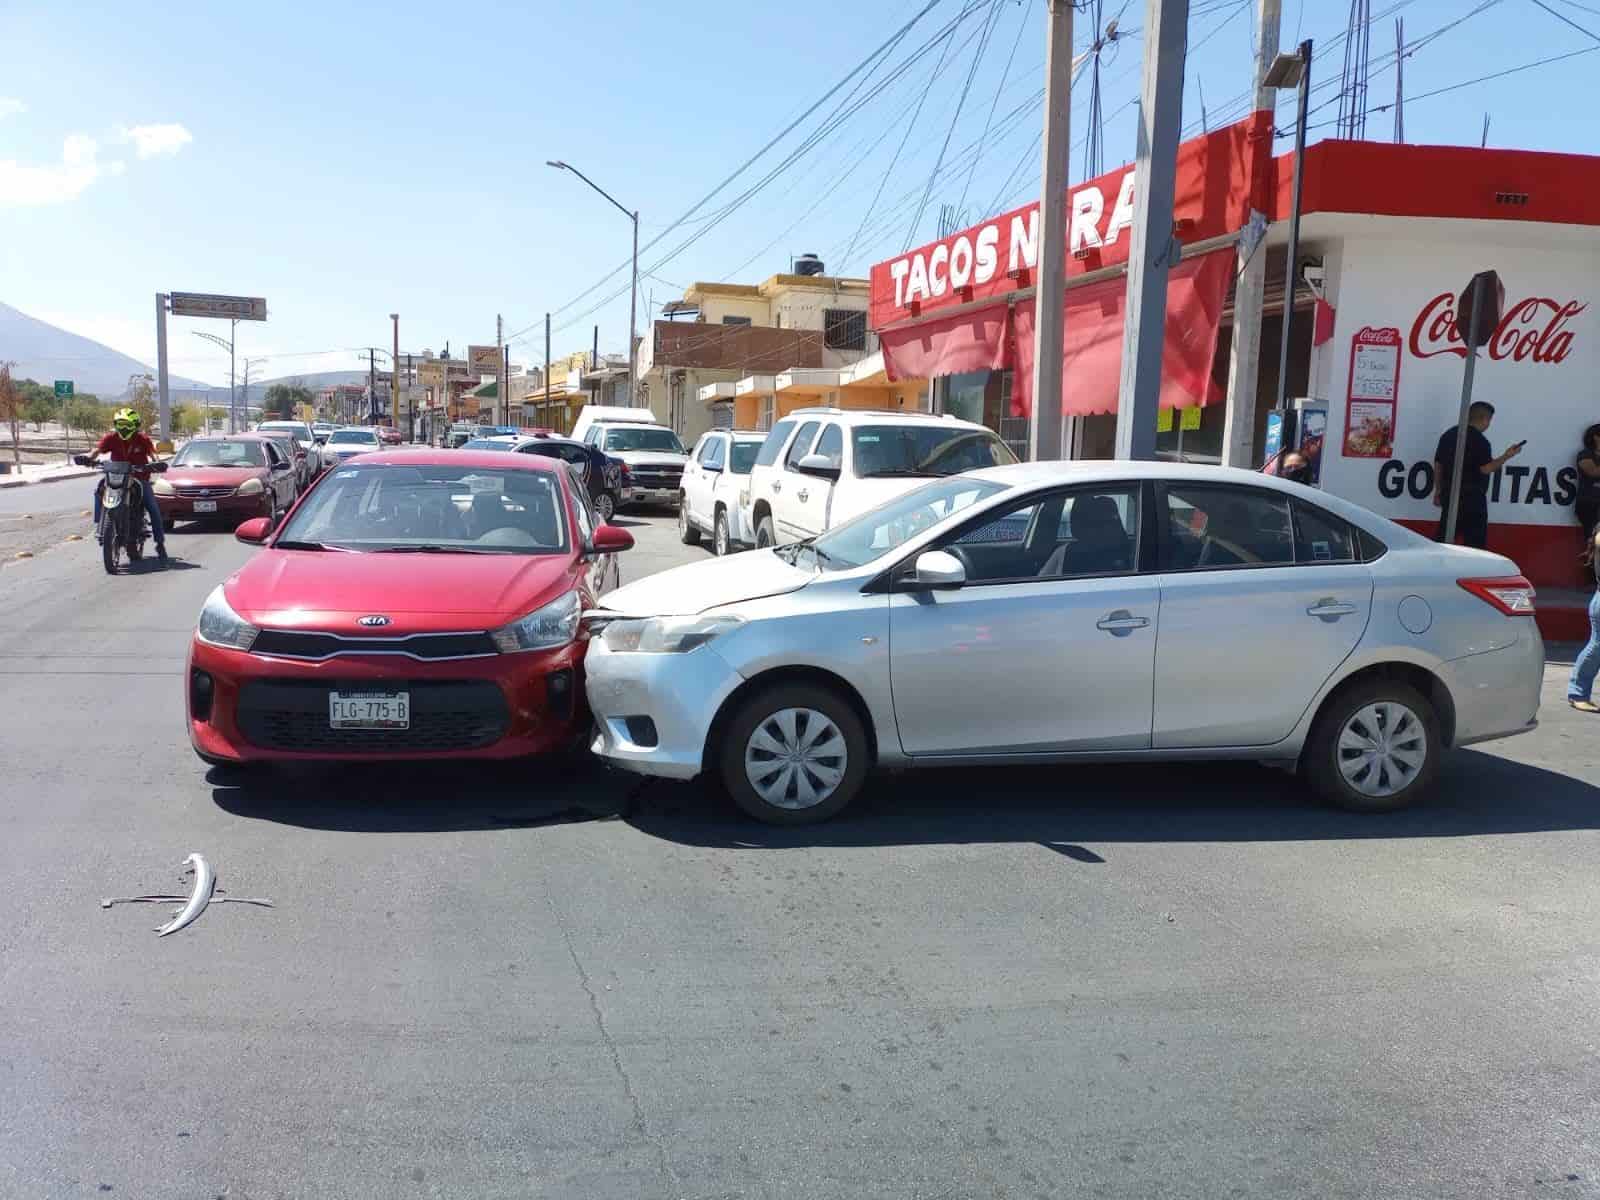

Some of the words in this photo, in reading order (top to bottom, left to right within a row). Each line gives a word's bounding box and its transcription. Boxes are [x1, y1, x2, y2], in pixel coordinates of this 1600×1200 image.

[890, 225, 999, 308] TACOS
[1008, 170, 1137, 281] NRA
[1378, 459, 1578, 506] GOITAS
[359, 616, 387, 626] KIA
